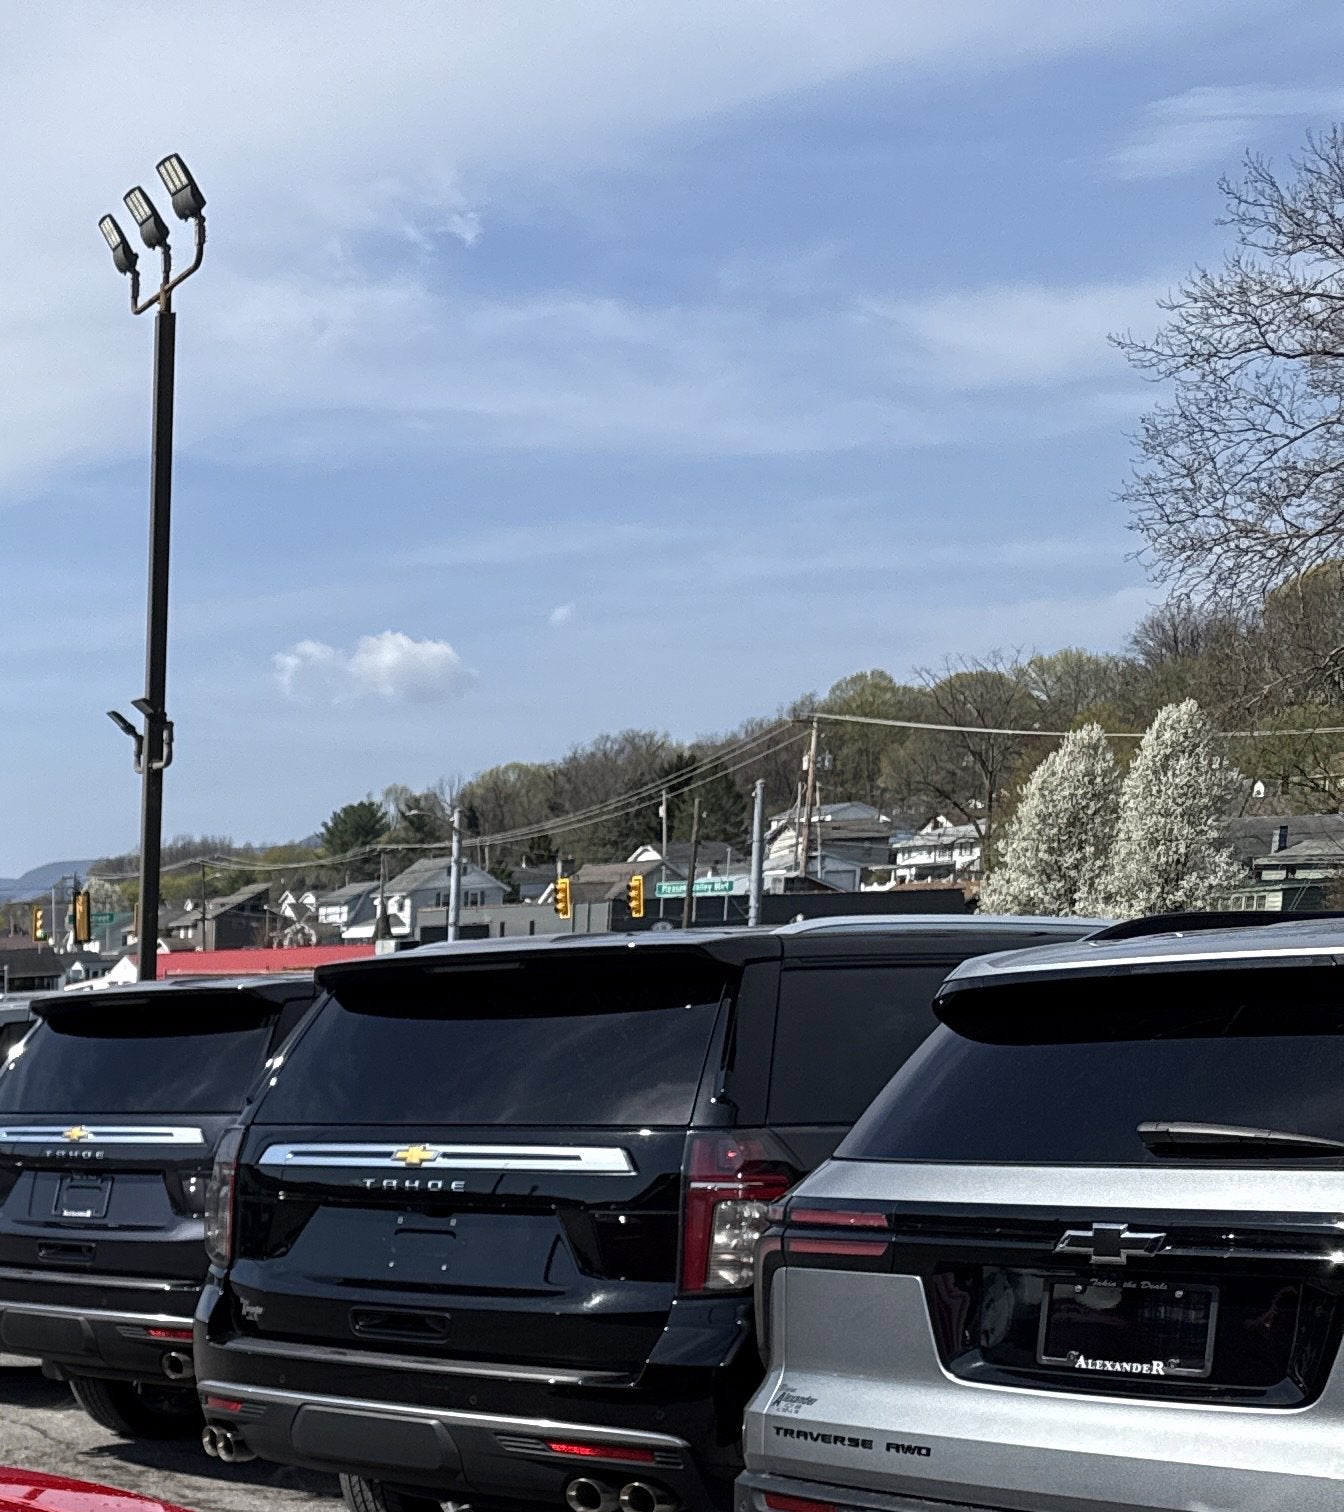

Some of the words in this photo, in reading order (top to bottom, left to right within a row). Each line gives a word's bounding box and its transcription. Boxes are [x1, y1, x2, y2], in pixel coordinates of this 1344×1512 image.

[45, 1149, 105, 1159] TAHOE
[362, 1178, 466, 1192] TAHOE
[1075, 1355, 1165, 1375] ALEXANDER
[773, 1425, 874, 1450] TRAVERSE
[885, 1442, 932, 1457] AWD
